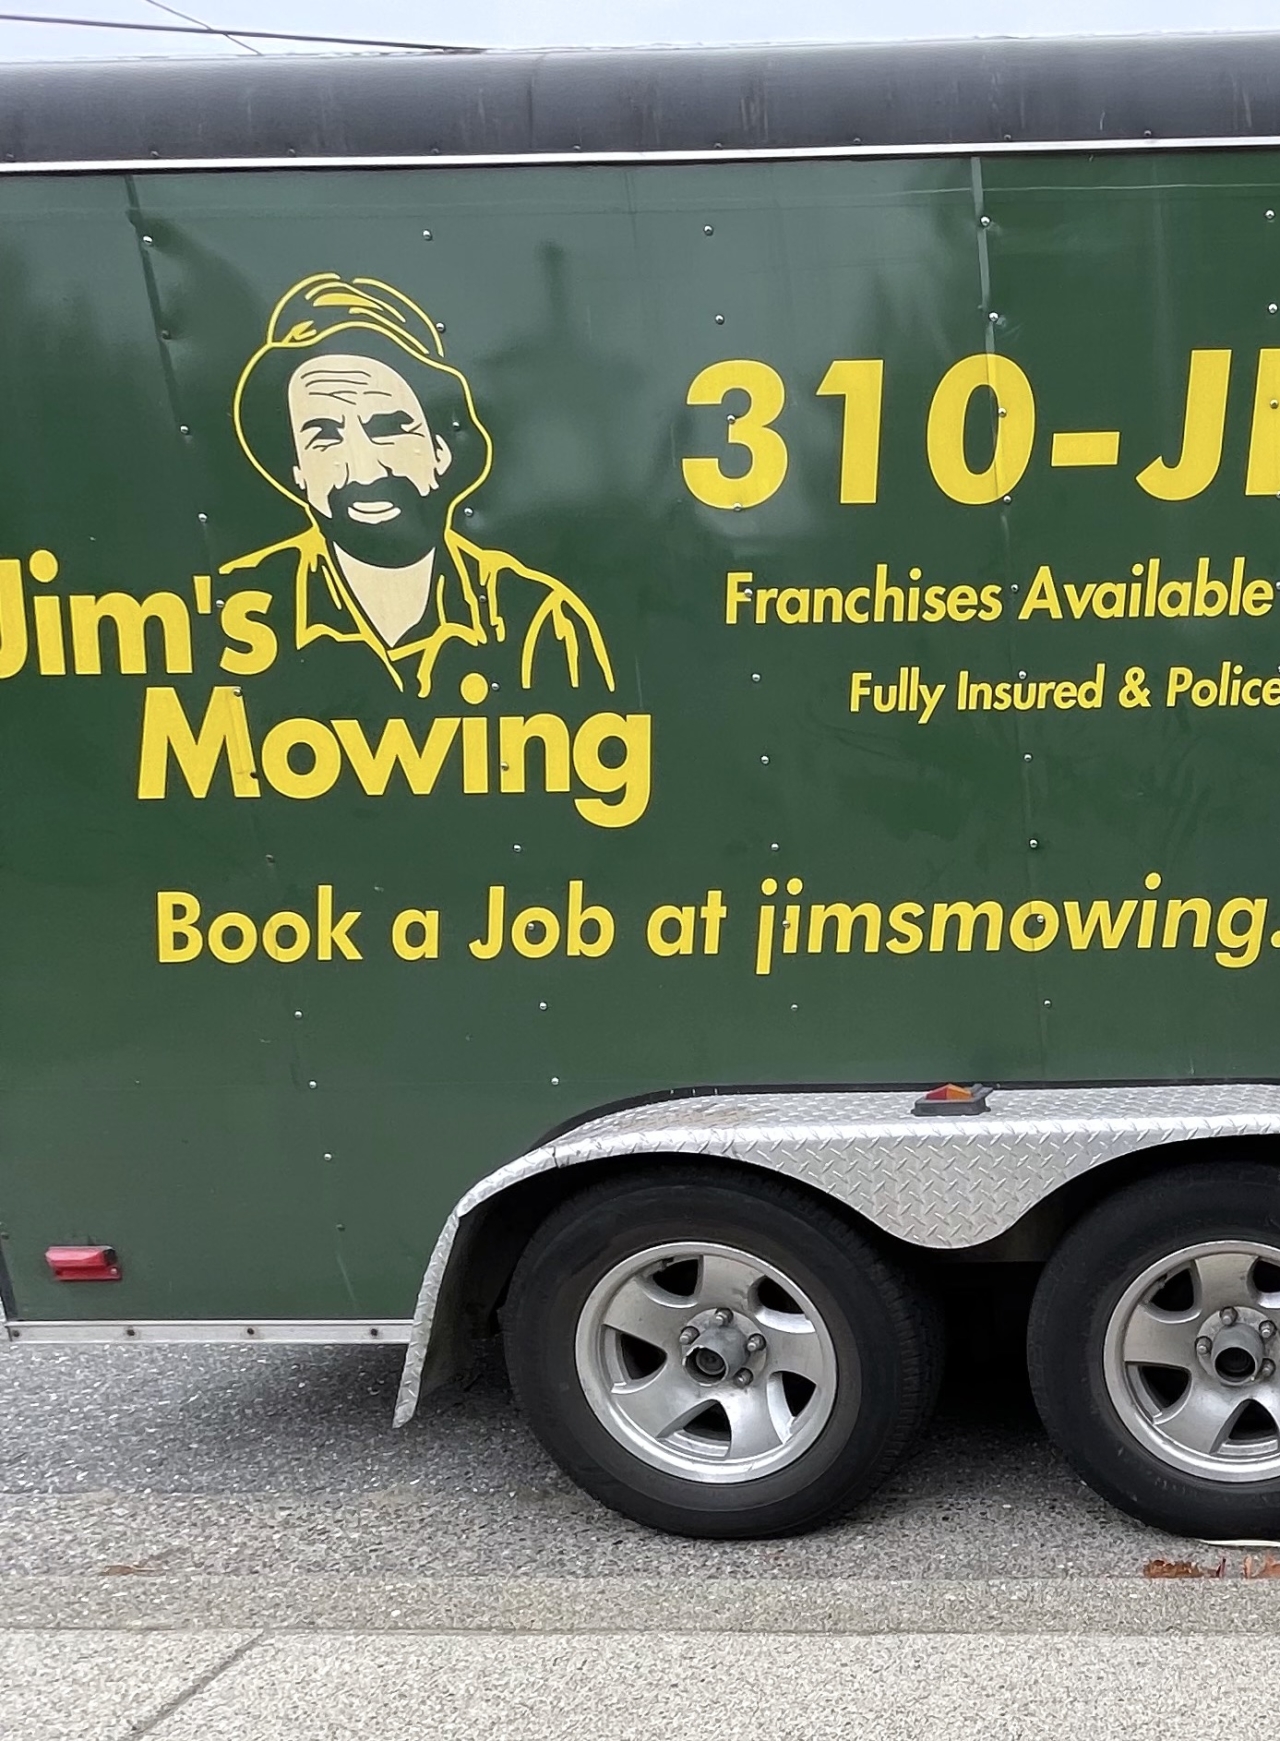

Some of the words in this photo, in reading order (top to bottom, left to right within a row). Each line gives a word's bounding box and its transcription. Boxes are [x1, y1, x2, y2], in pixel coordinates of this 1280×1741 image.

[0, 549, 278, 679] Jim's
[725, 563, 1003, 625] Franchises
[1018, 556, 1274, 620] Available
[850, 666, 945, 724] Fully
[957, 662, 1106, 711] Insured
[1118, 666, 1151, 709] &
[137, 672, 652, 828] Mowing
[157, 884, 363, 964] Book
[391, 908, 440, 961] a
[468, 879, 615, 960] Job
[646, 889, 728, 957] at
